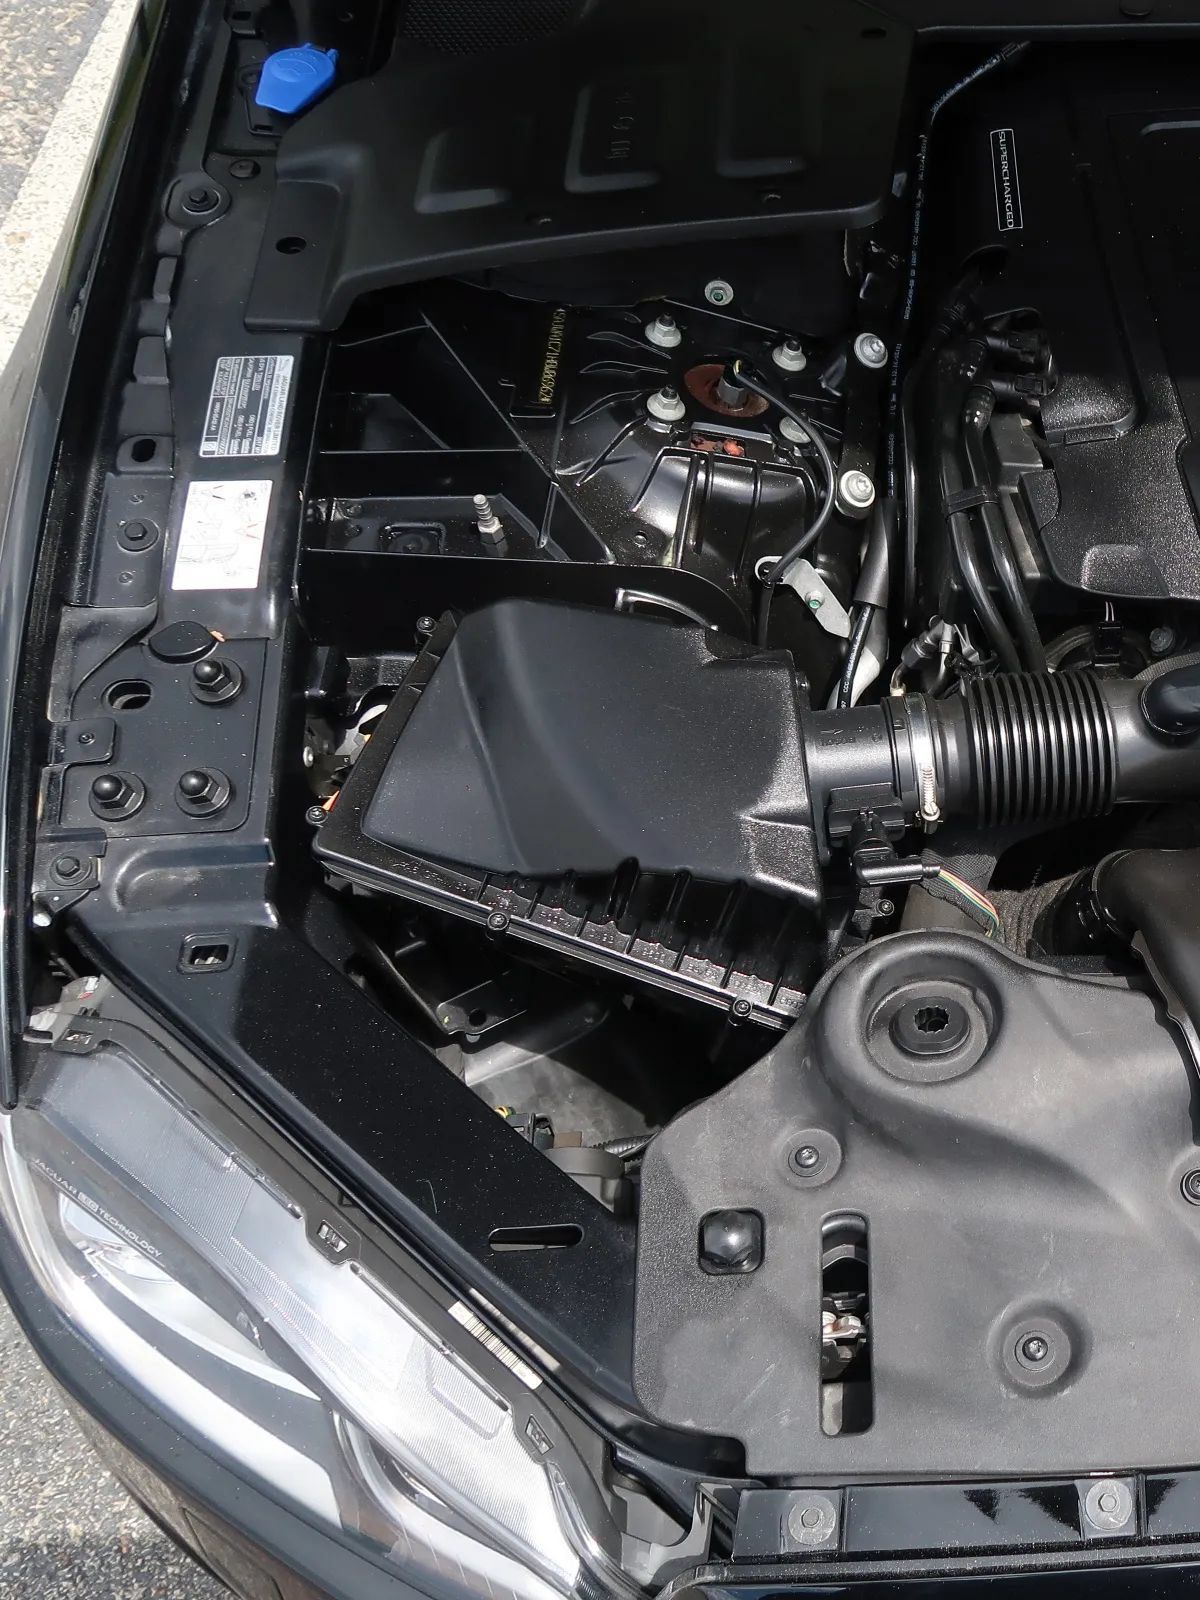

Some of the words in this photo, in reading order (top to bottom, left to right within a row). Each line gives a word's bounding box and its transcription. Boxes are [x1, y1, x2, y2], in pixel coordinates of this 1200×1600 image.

[999, 131, 1014, 228] SUPERCHARGED
[32, 1157, 78, 1196] JAGUAR
[98, 1207, 163, 1259] TECHNOLOGY
